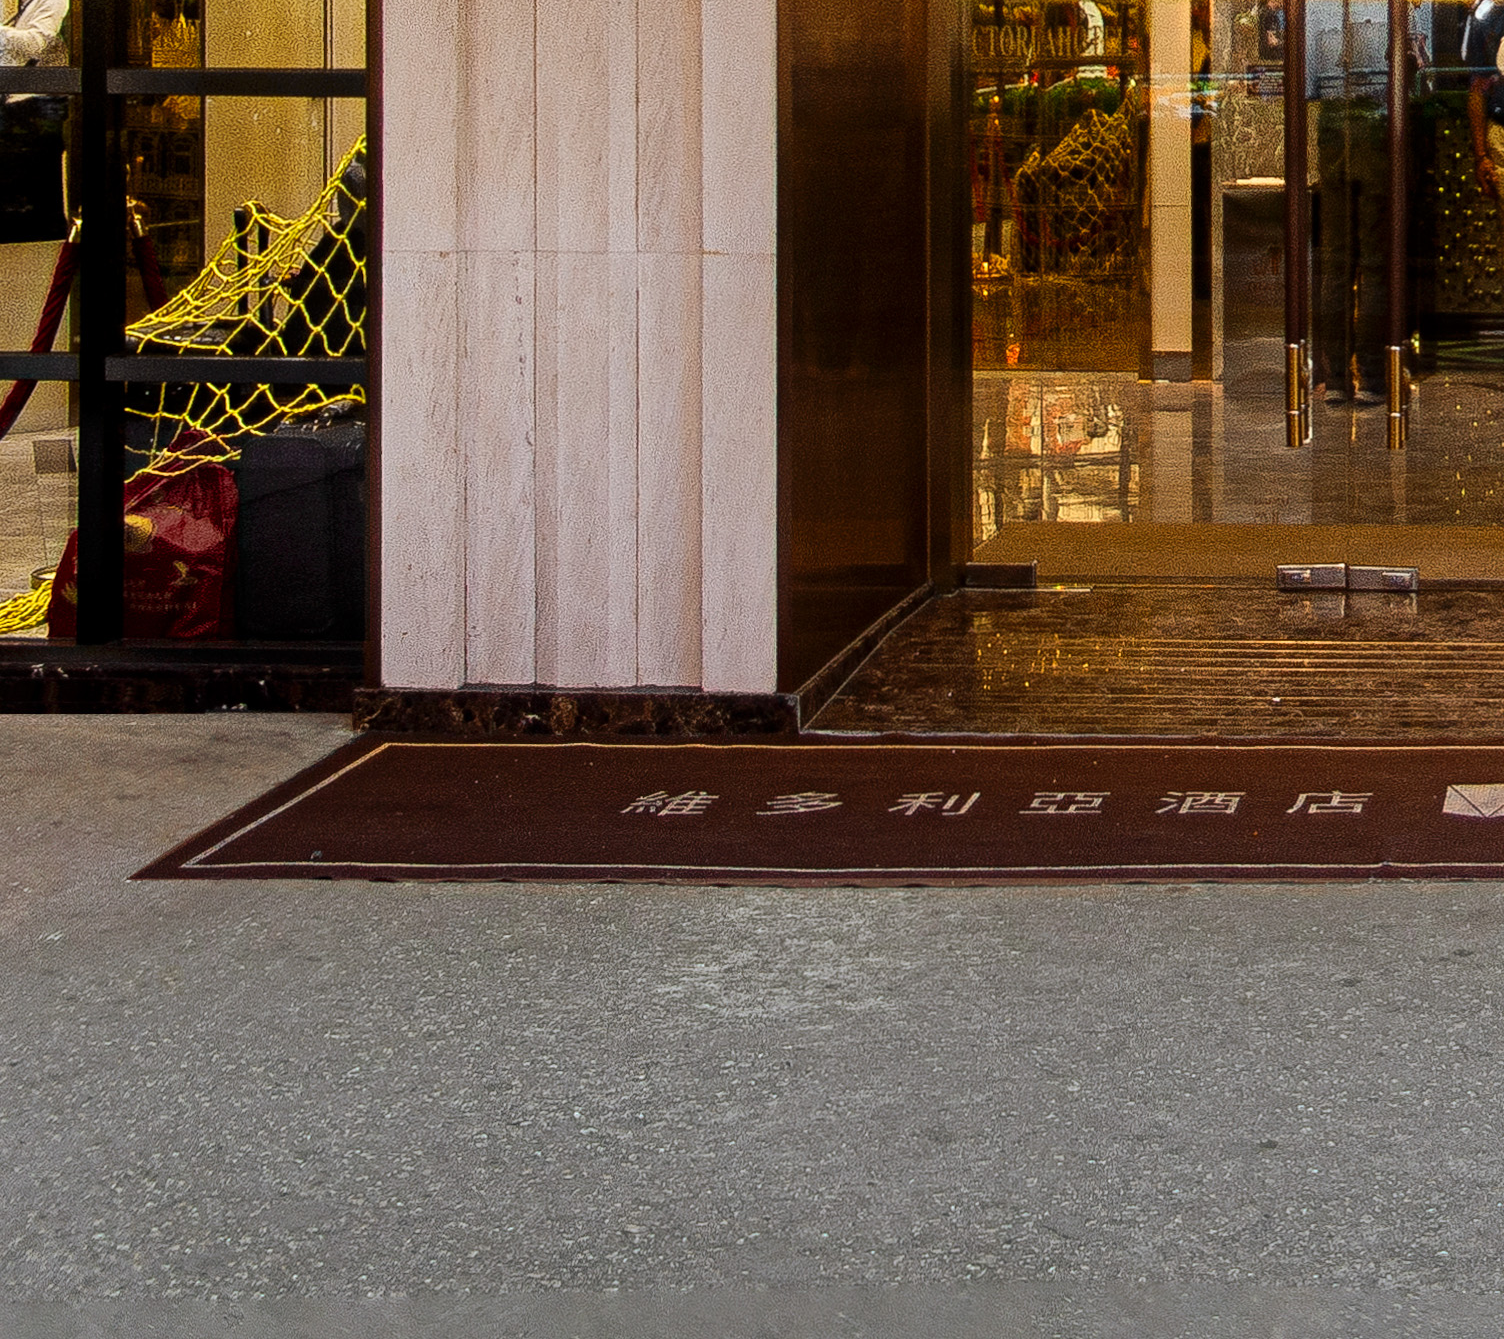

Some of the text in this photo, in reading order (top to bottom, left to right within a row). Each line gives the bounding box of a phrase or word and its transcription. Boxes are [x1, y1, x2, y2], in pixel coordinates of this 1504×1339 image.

[620, 790, 1374, 817] 維多利亞酒店
